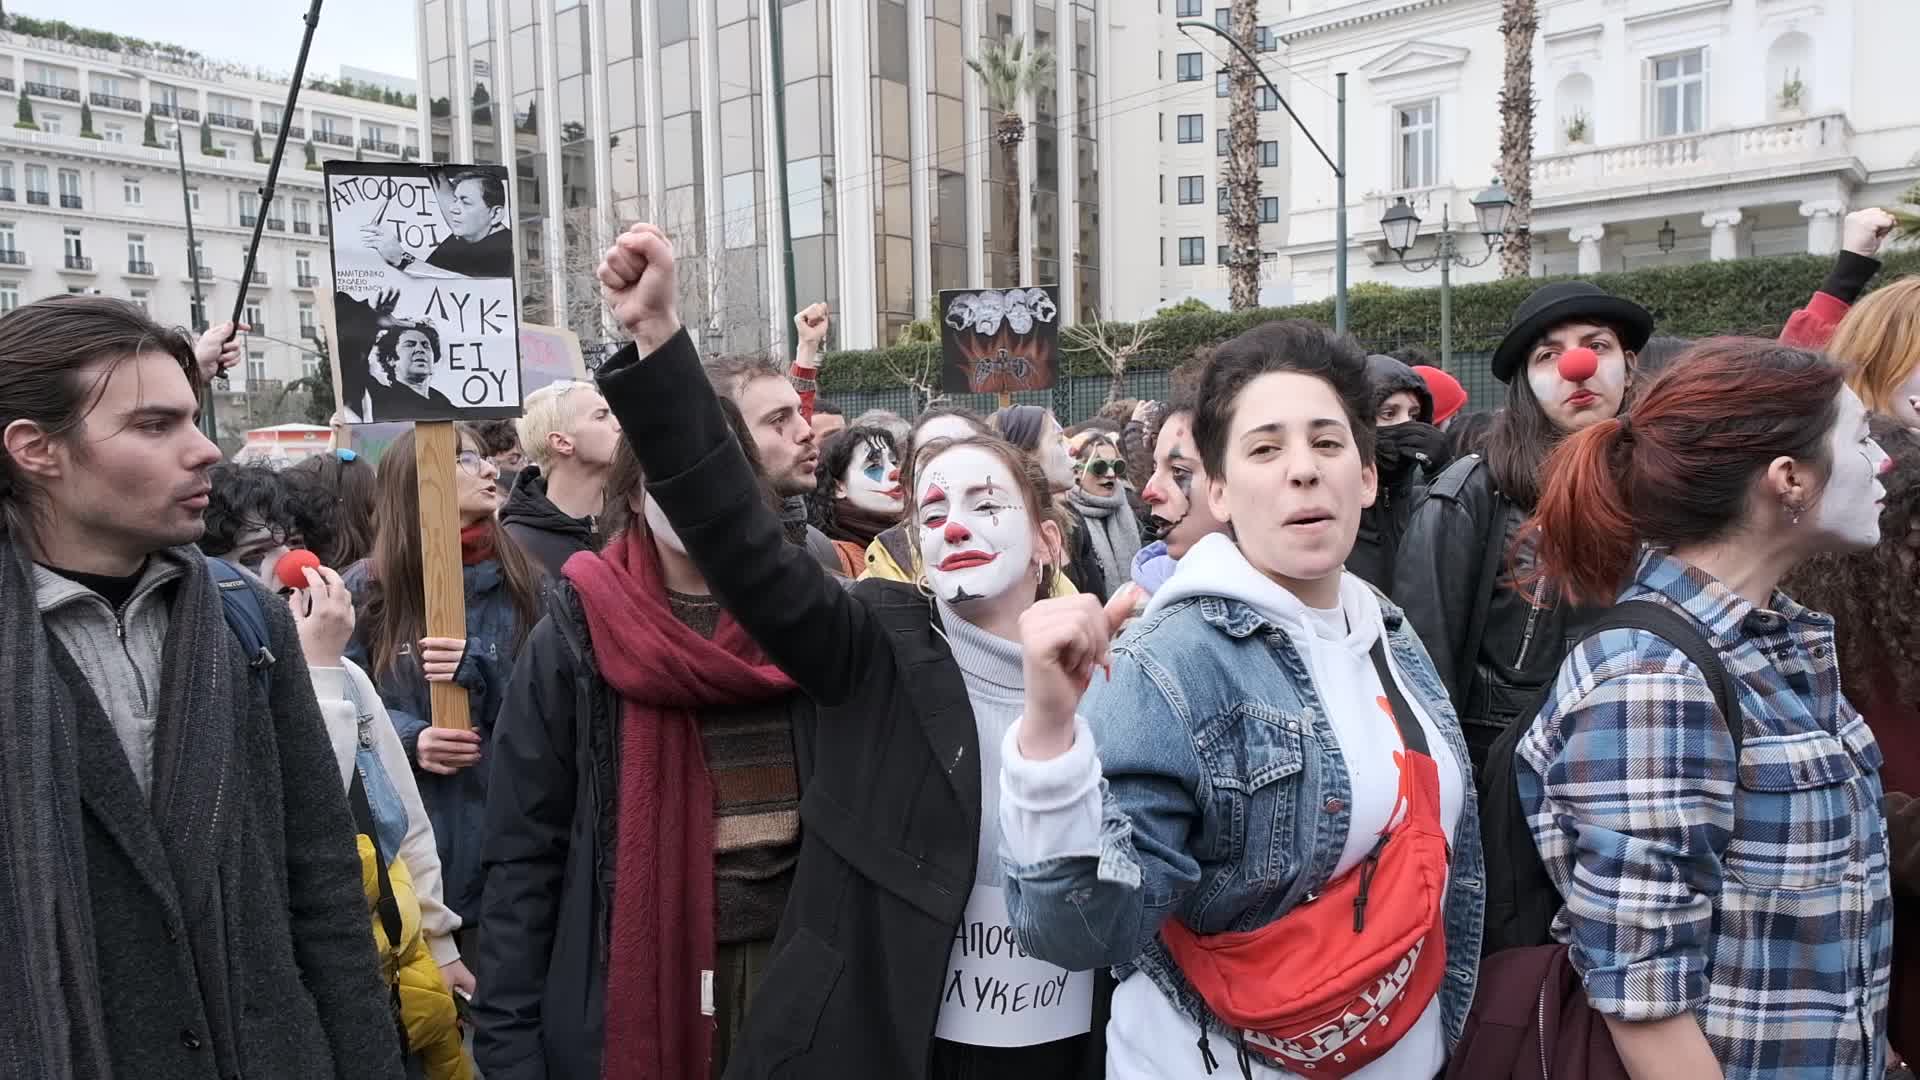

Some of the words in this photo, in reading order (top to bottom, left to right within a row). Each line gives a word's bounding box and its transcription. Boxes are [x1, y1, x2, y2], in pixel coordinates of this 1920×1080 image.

[387, 219, 441, 248] ΤΟΙ
[424, 286, 508, 335] ΛΥΚ-
[449, 342, 489, 372] ΕΙ
[462, 369, 506, 405] ΟΥ
[953, 918, 1029, 959] ΑΠΟΦ
[945, 969, 1069, 1015] ΛΥΚΕΙΟΥ
